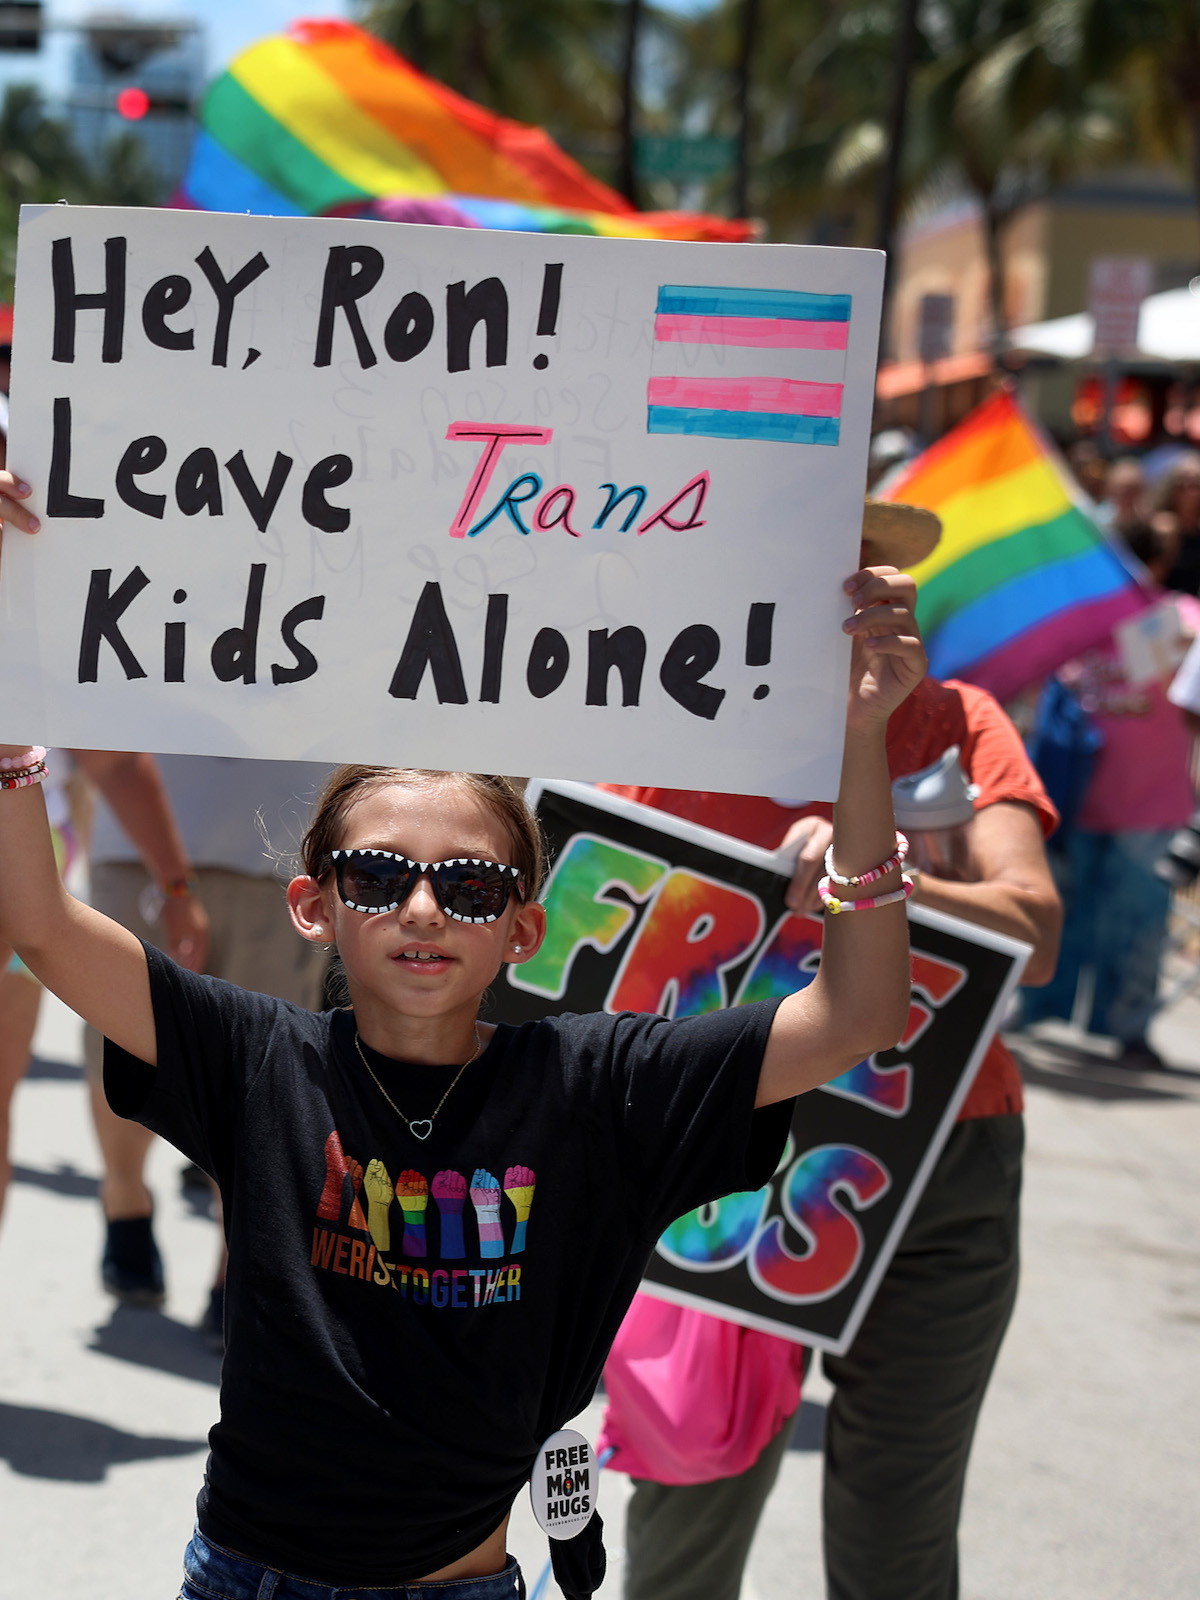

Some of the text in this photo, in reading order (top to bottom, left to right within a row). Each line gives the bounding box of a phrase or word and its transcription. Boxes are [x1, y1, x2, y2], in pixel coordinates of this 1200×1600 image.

[313, 245, 564, 373] Ron!
[46, 397, 353, 533] Leave
[78, 563, 775, 720] Kids Alone!
[544, 1443, 589, 1471] FREE
[546, 1468, 590, 1498] MOM
[547, 1495, 590, 1520] HUGS
